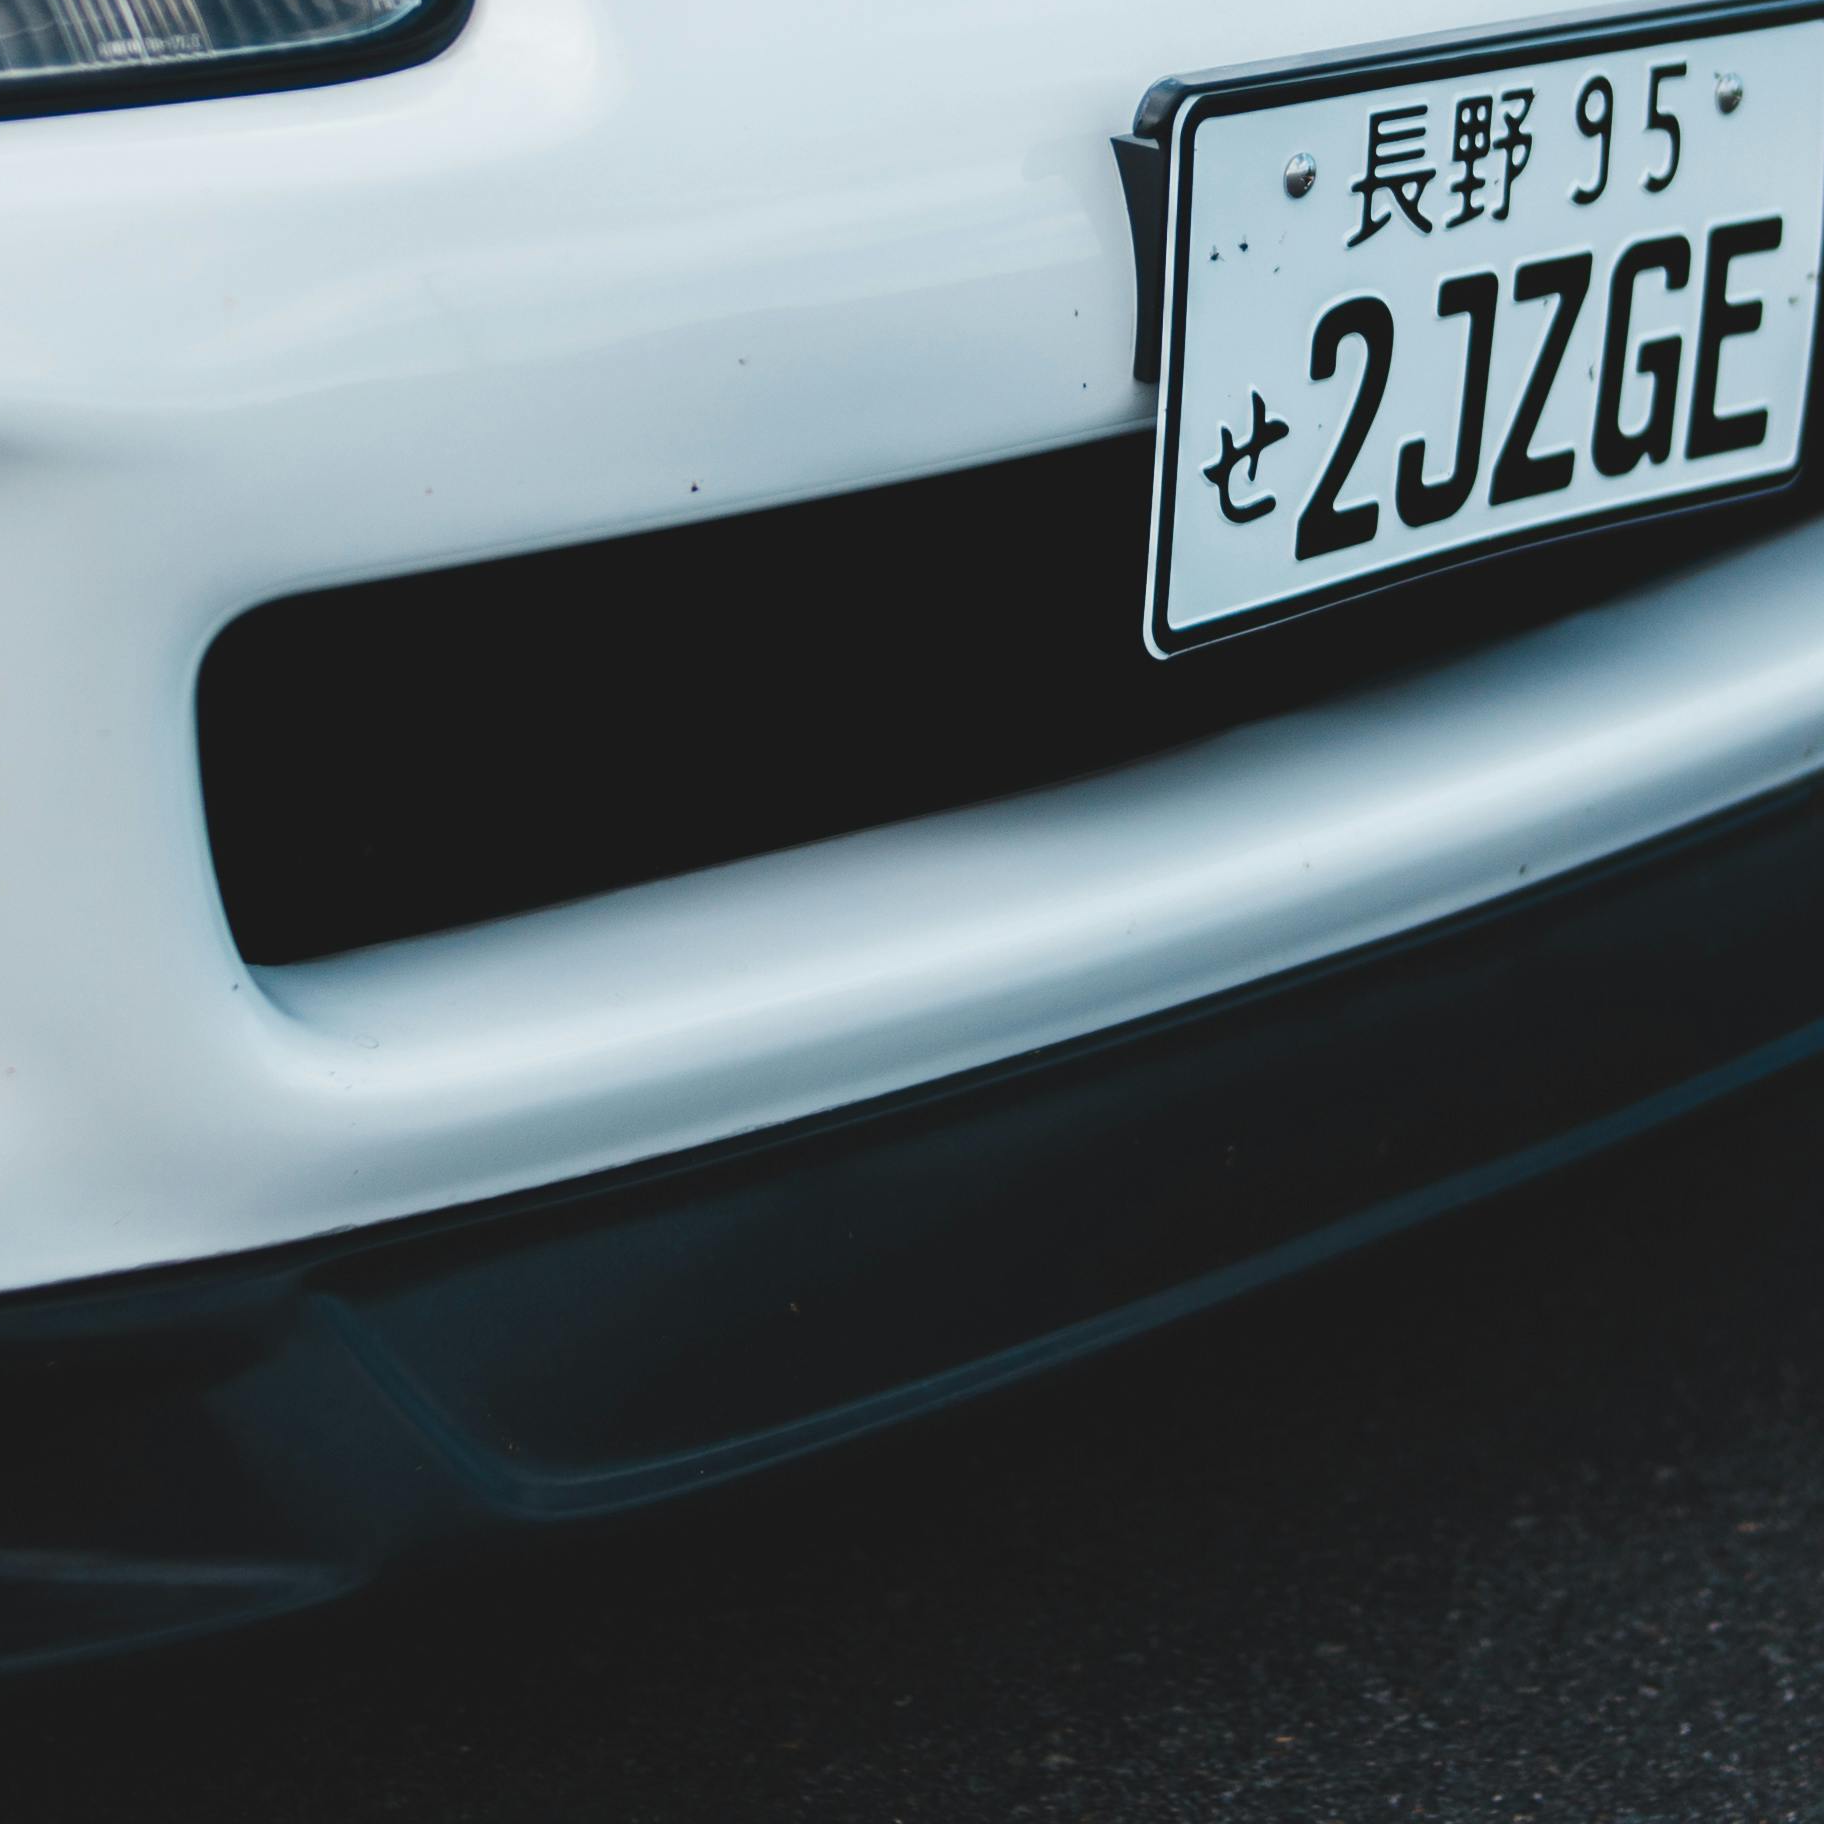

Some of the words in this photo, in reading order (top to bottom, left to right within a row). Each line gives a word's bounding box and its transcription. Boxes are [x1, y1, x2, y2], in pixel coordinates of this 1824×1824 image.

[1343, 87, 1536, 248] 長野
[1570, 59, 1689, 205] 95
[1201, 387, 1290, 524] せ
[1294, 214, 1783, 561] 2JZGE
